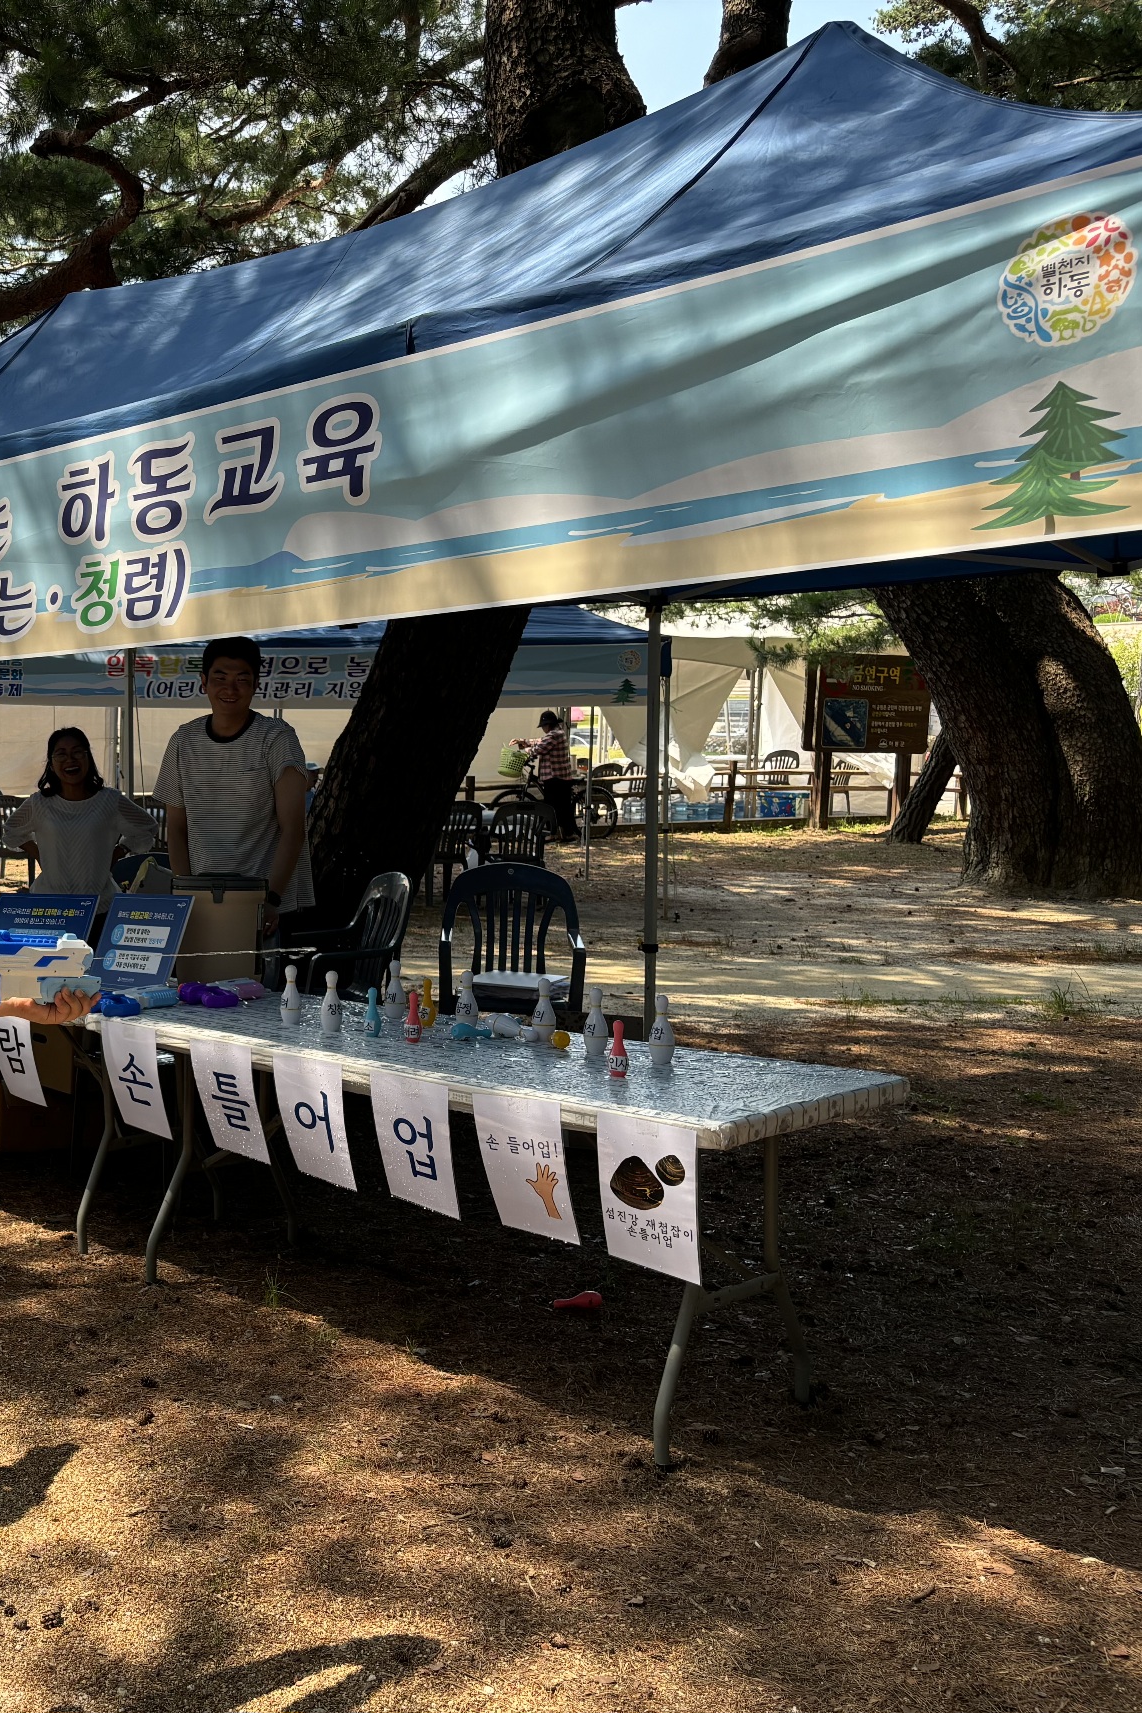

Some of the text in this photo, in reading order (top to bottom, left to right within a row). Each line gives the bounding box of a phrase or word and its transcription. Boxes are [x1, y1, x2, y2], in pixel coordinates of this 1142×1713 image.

[1041, 254, 1091, 279] 별천지
[61, 401, 377, 542] 하동교육
[259, 656, 330, 677] 첩으로
[853, 664, 901, 685] 금연구역
[324, 681, 362, 699] 지원
[118, 1052, 154, 1107] 손
[211, 1070, 251, 1132] 틀
[294, 1090, 335, 1154] 어
[393, 1115, 438, 1181] 업
[485, 1133, 559, 1159] 손 들어업!
[605, 1206, 693, 1243] 섬진강 재첩잡이
